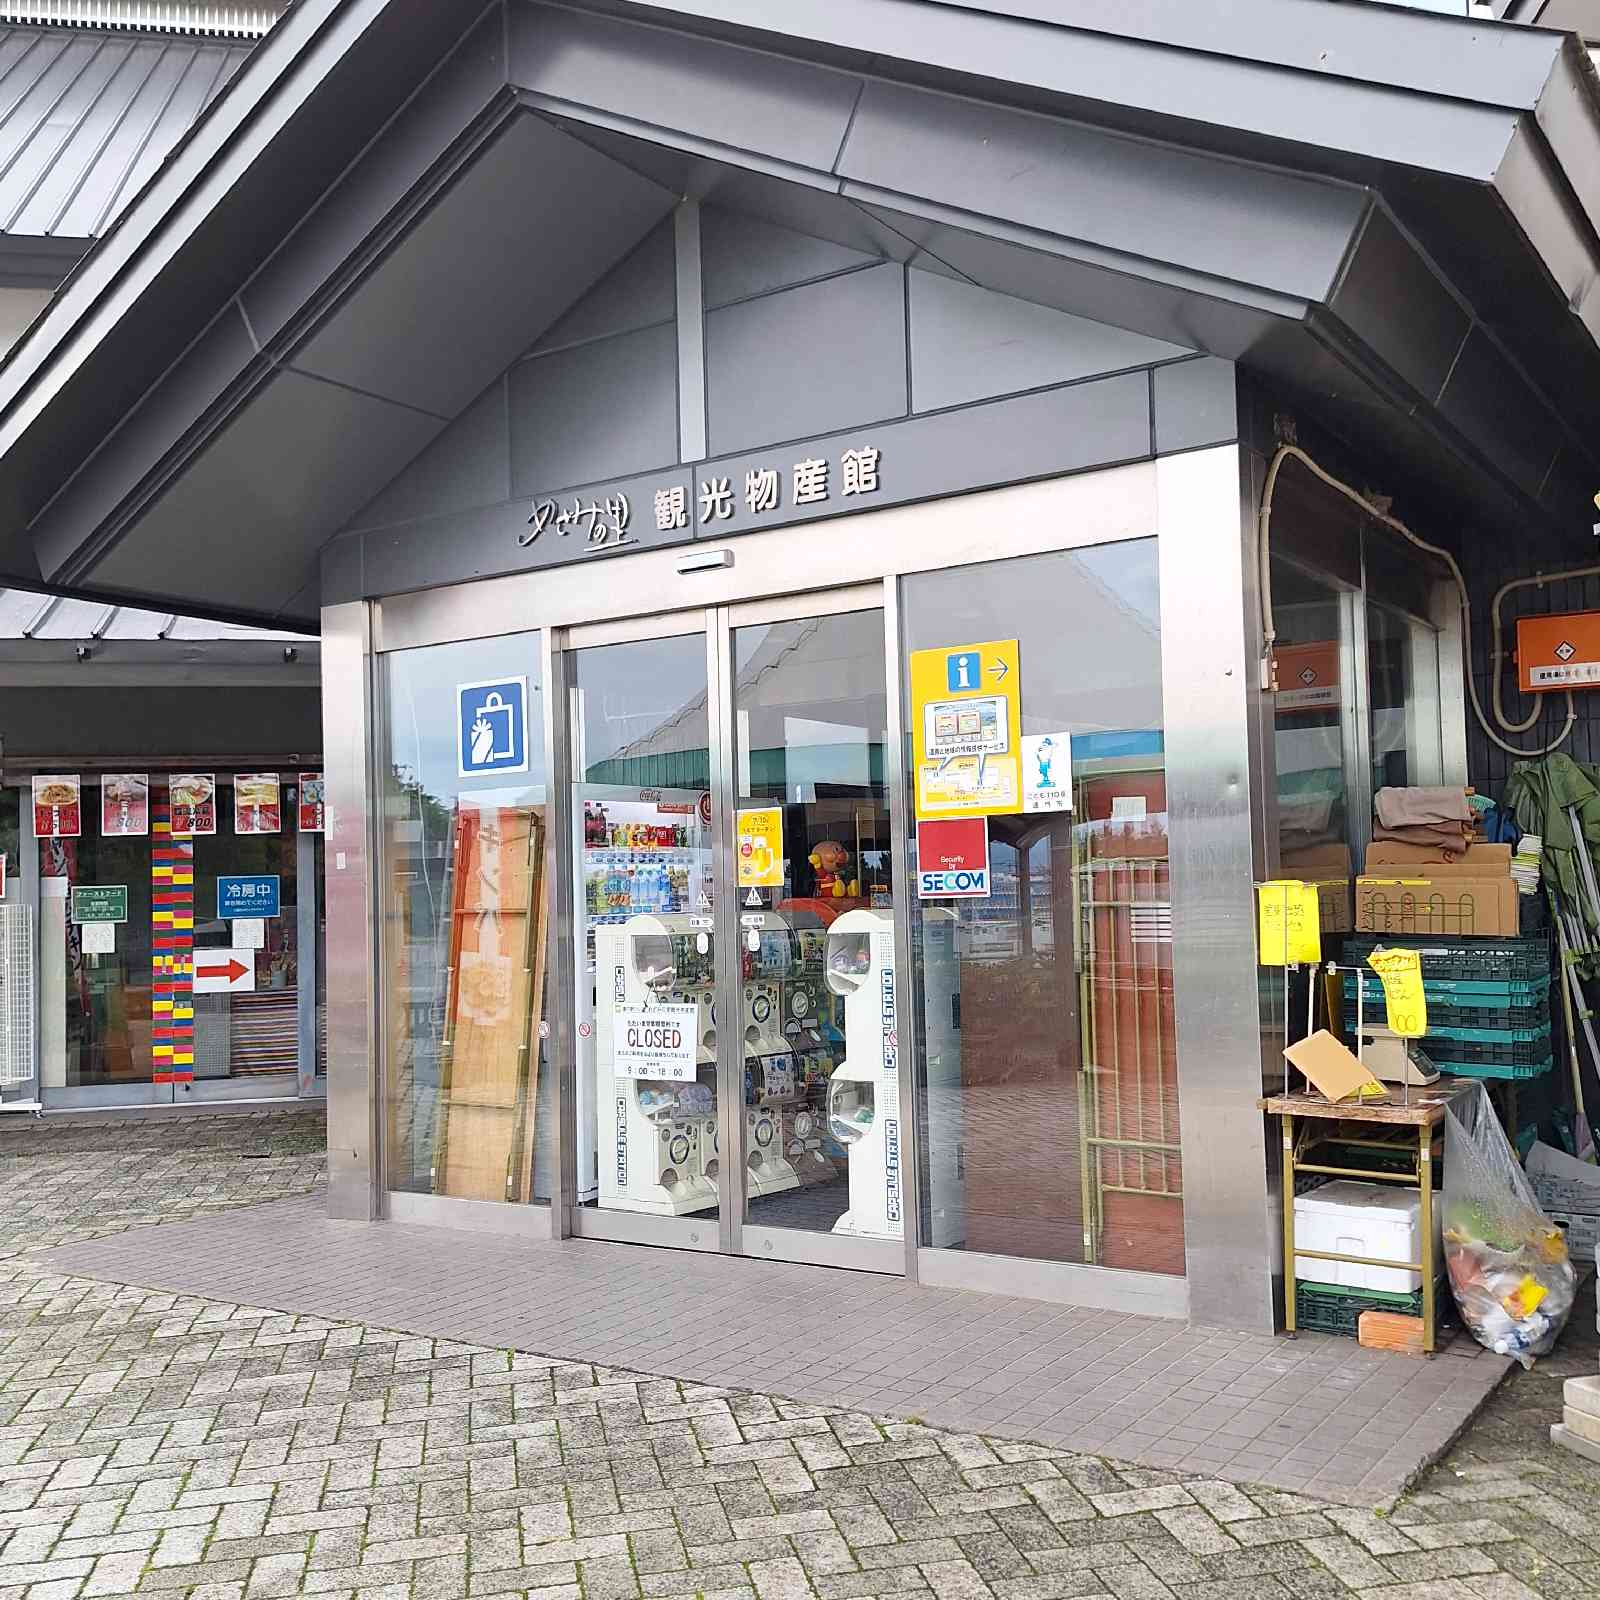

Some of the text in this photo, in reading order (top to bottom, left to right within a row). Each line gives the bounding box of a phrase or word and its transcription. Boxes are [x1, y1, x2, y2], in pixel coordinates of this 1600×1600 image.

[653, 446, 880, 531] 観光物産館
[940, 855, 965, 864] Security
[226, 883, 271, 898] 冷房中
[922, 872, 984, 891] SECOM
[627, 1028, 682, 1049] CLOSED
[884, 1119, 900, 1221] CAPSULE STATION
